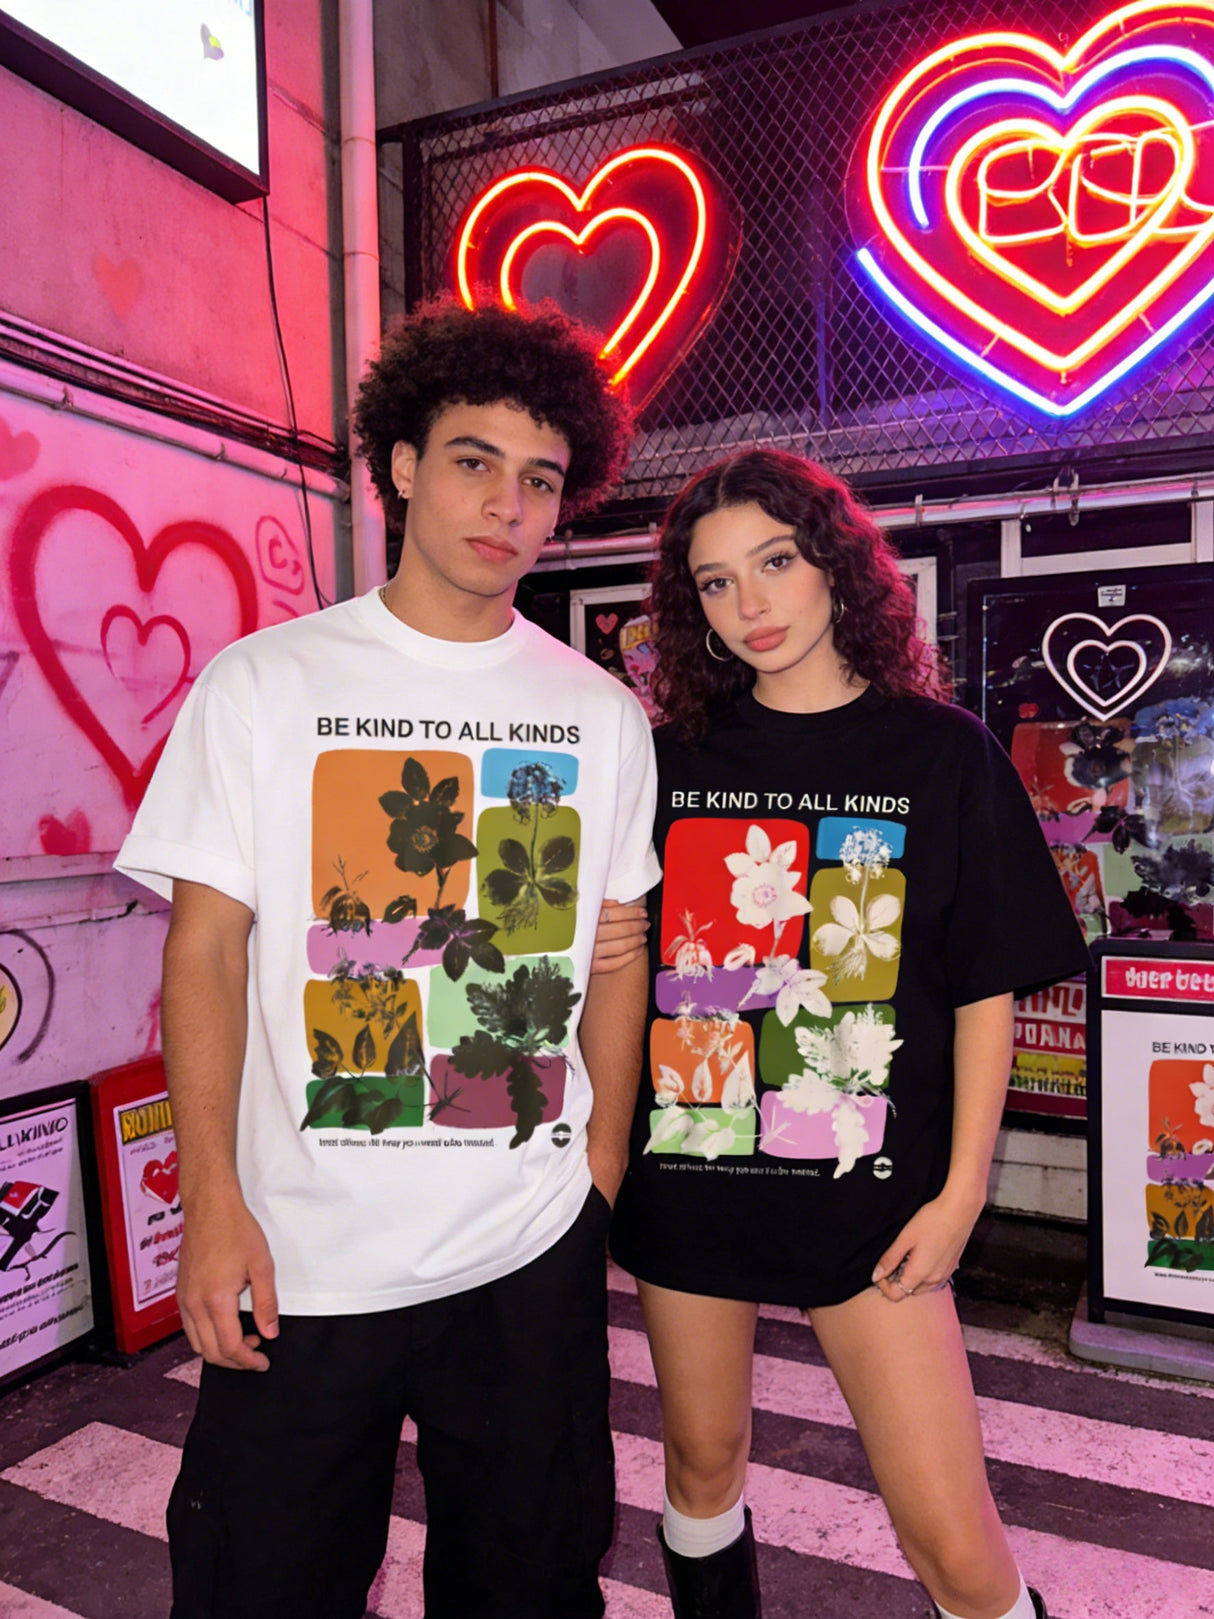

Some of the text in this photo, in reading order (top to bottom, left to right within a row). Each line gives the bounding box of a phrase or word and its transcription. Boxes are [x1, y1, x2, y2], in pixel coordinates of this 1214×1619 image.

[317, 717, 581, 744] BE KIND TO ALL KINDS
[671, 791, 910, 814] BE KIND TO ALL KINDS
[1152, 1041, 1171, 1054] BE
[1174, 1042, 1207, 1055] KIND
